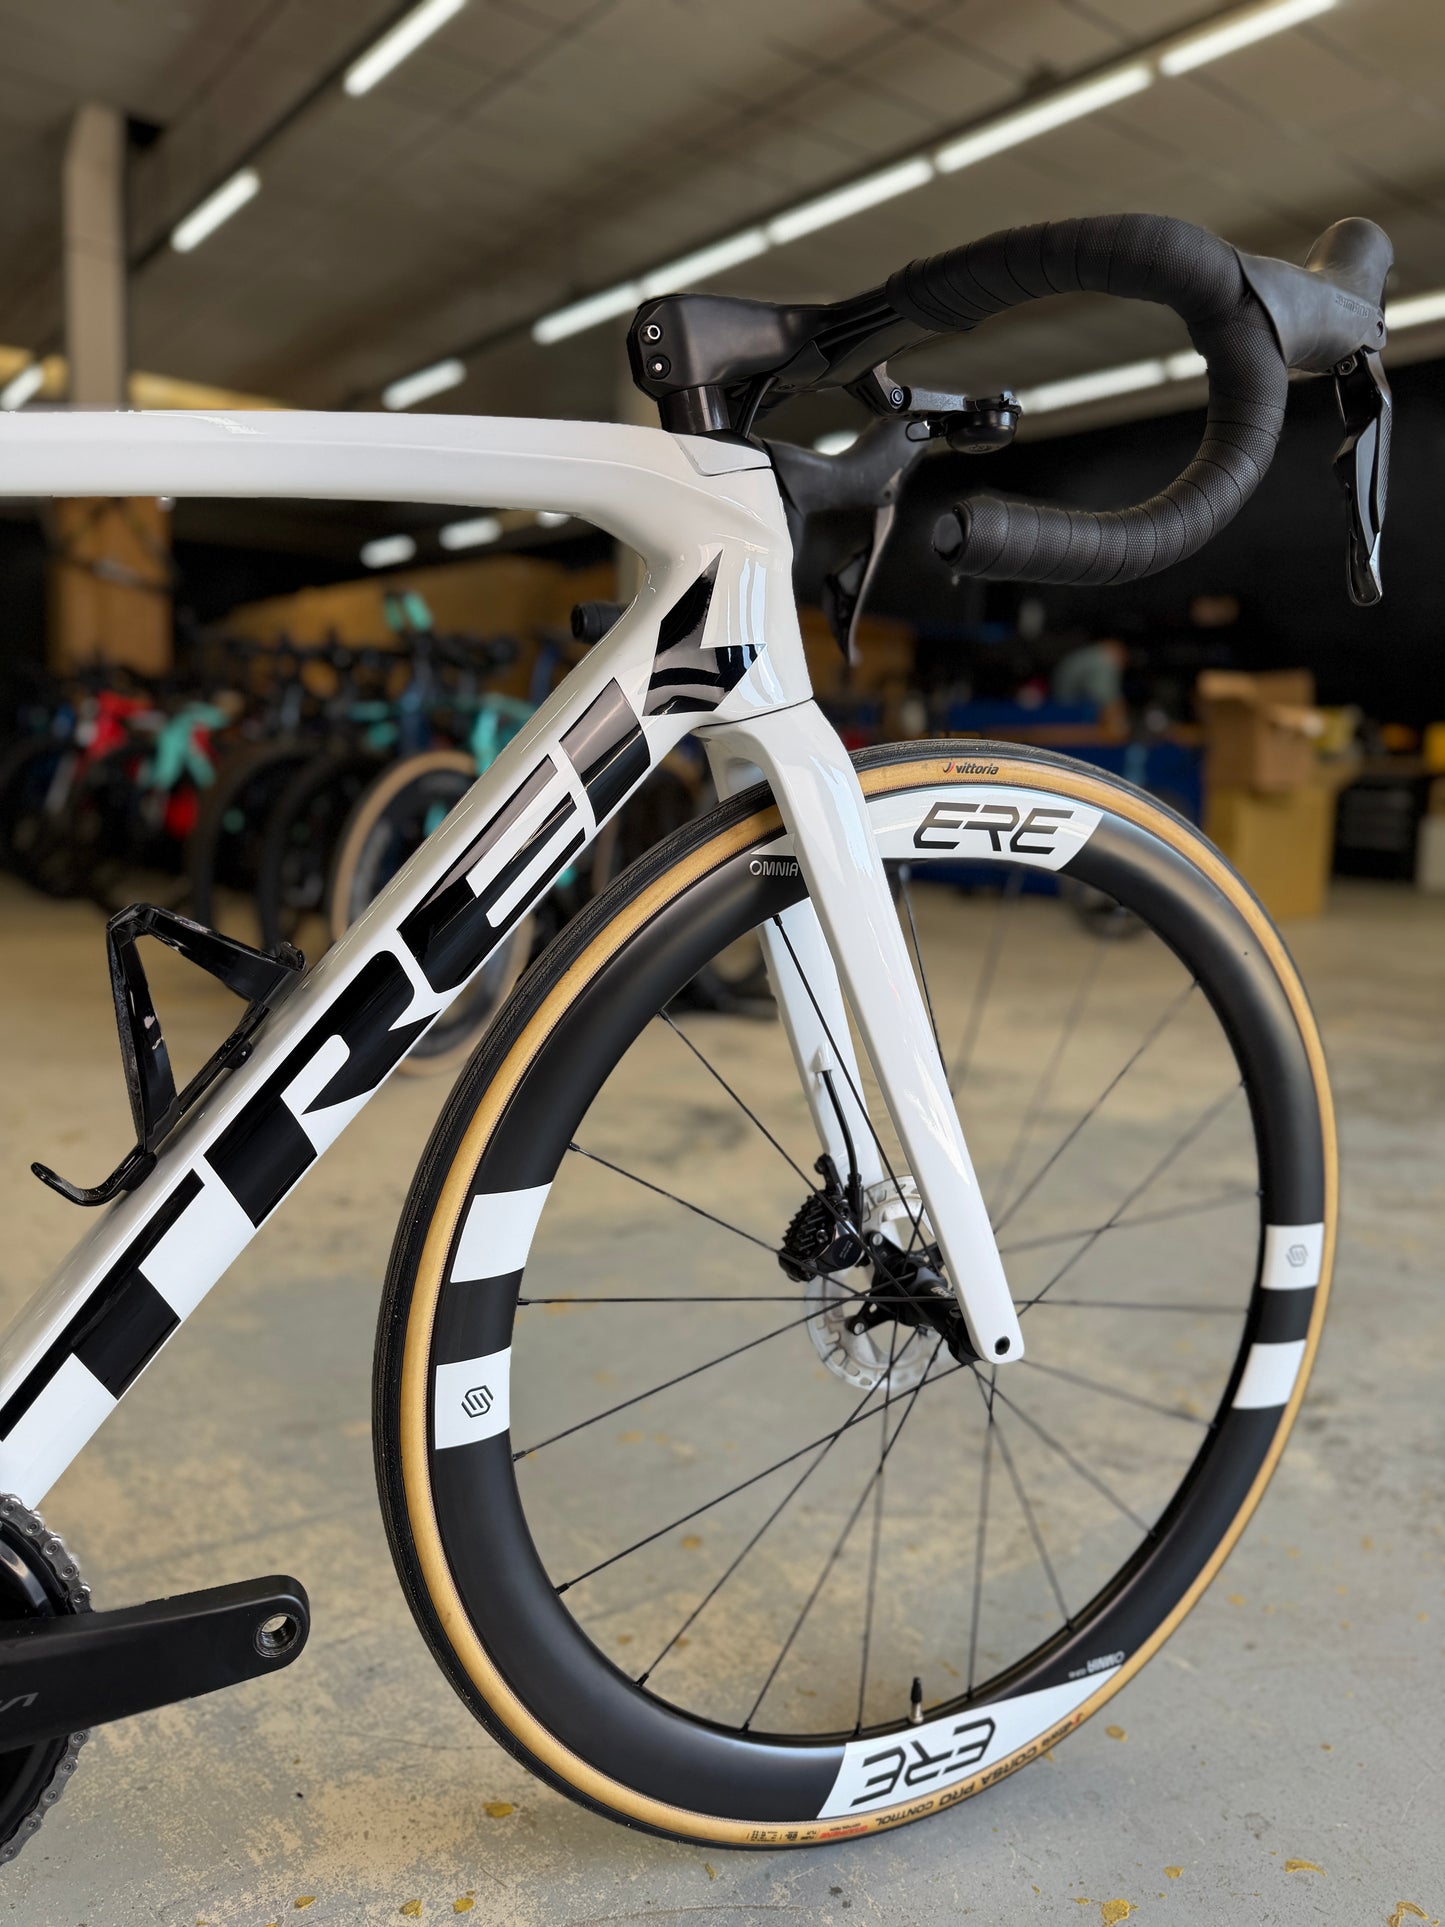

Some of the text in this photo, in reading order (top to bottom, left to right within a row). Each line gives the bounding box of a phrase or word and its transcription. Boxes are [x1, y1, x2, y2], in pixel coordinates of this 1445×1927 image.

[956, 762, 999, 775] vittoria
[913, 801, 1075, 855] ERE
[749, 860, 799, 877] OMNIA
[0, 548, 767, 1442] TREK
[850, 1717, 996, 1807] ERE
[876, 1746, 1037, 1826] CORSA PRO CONTROL
